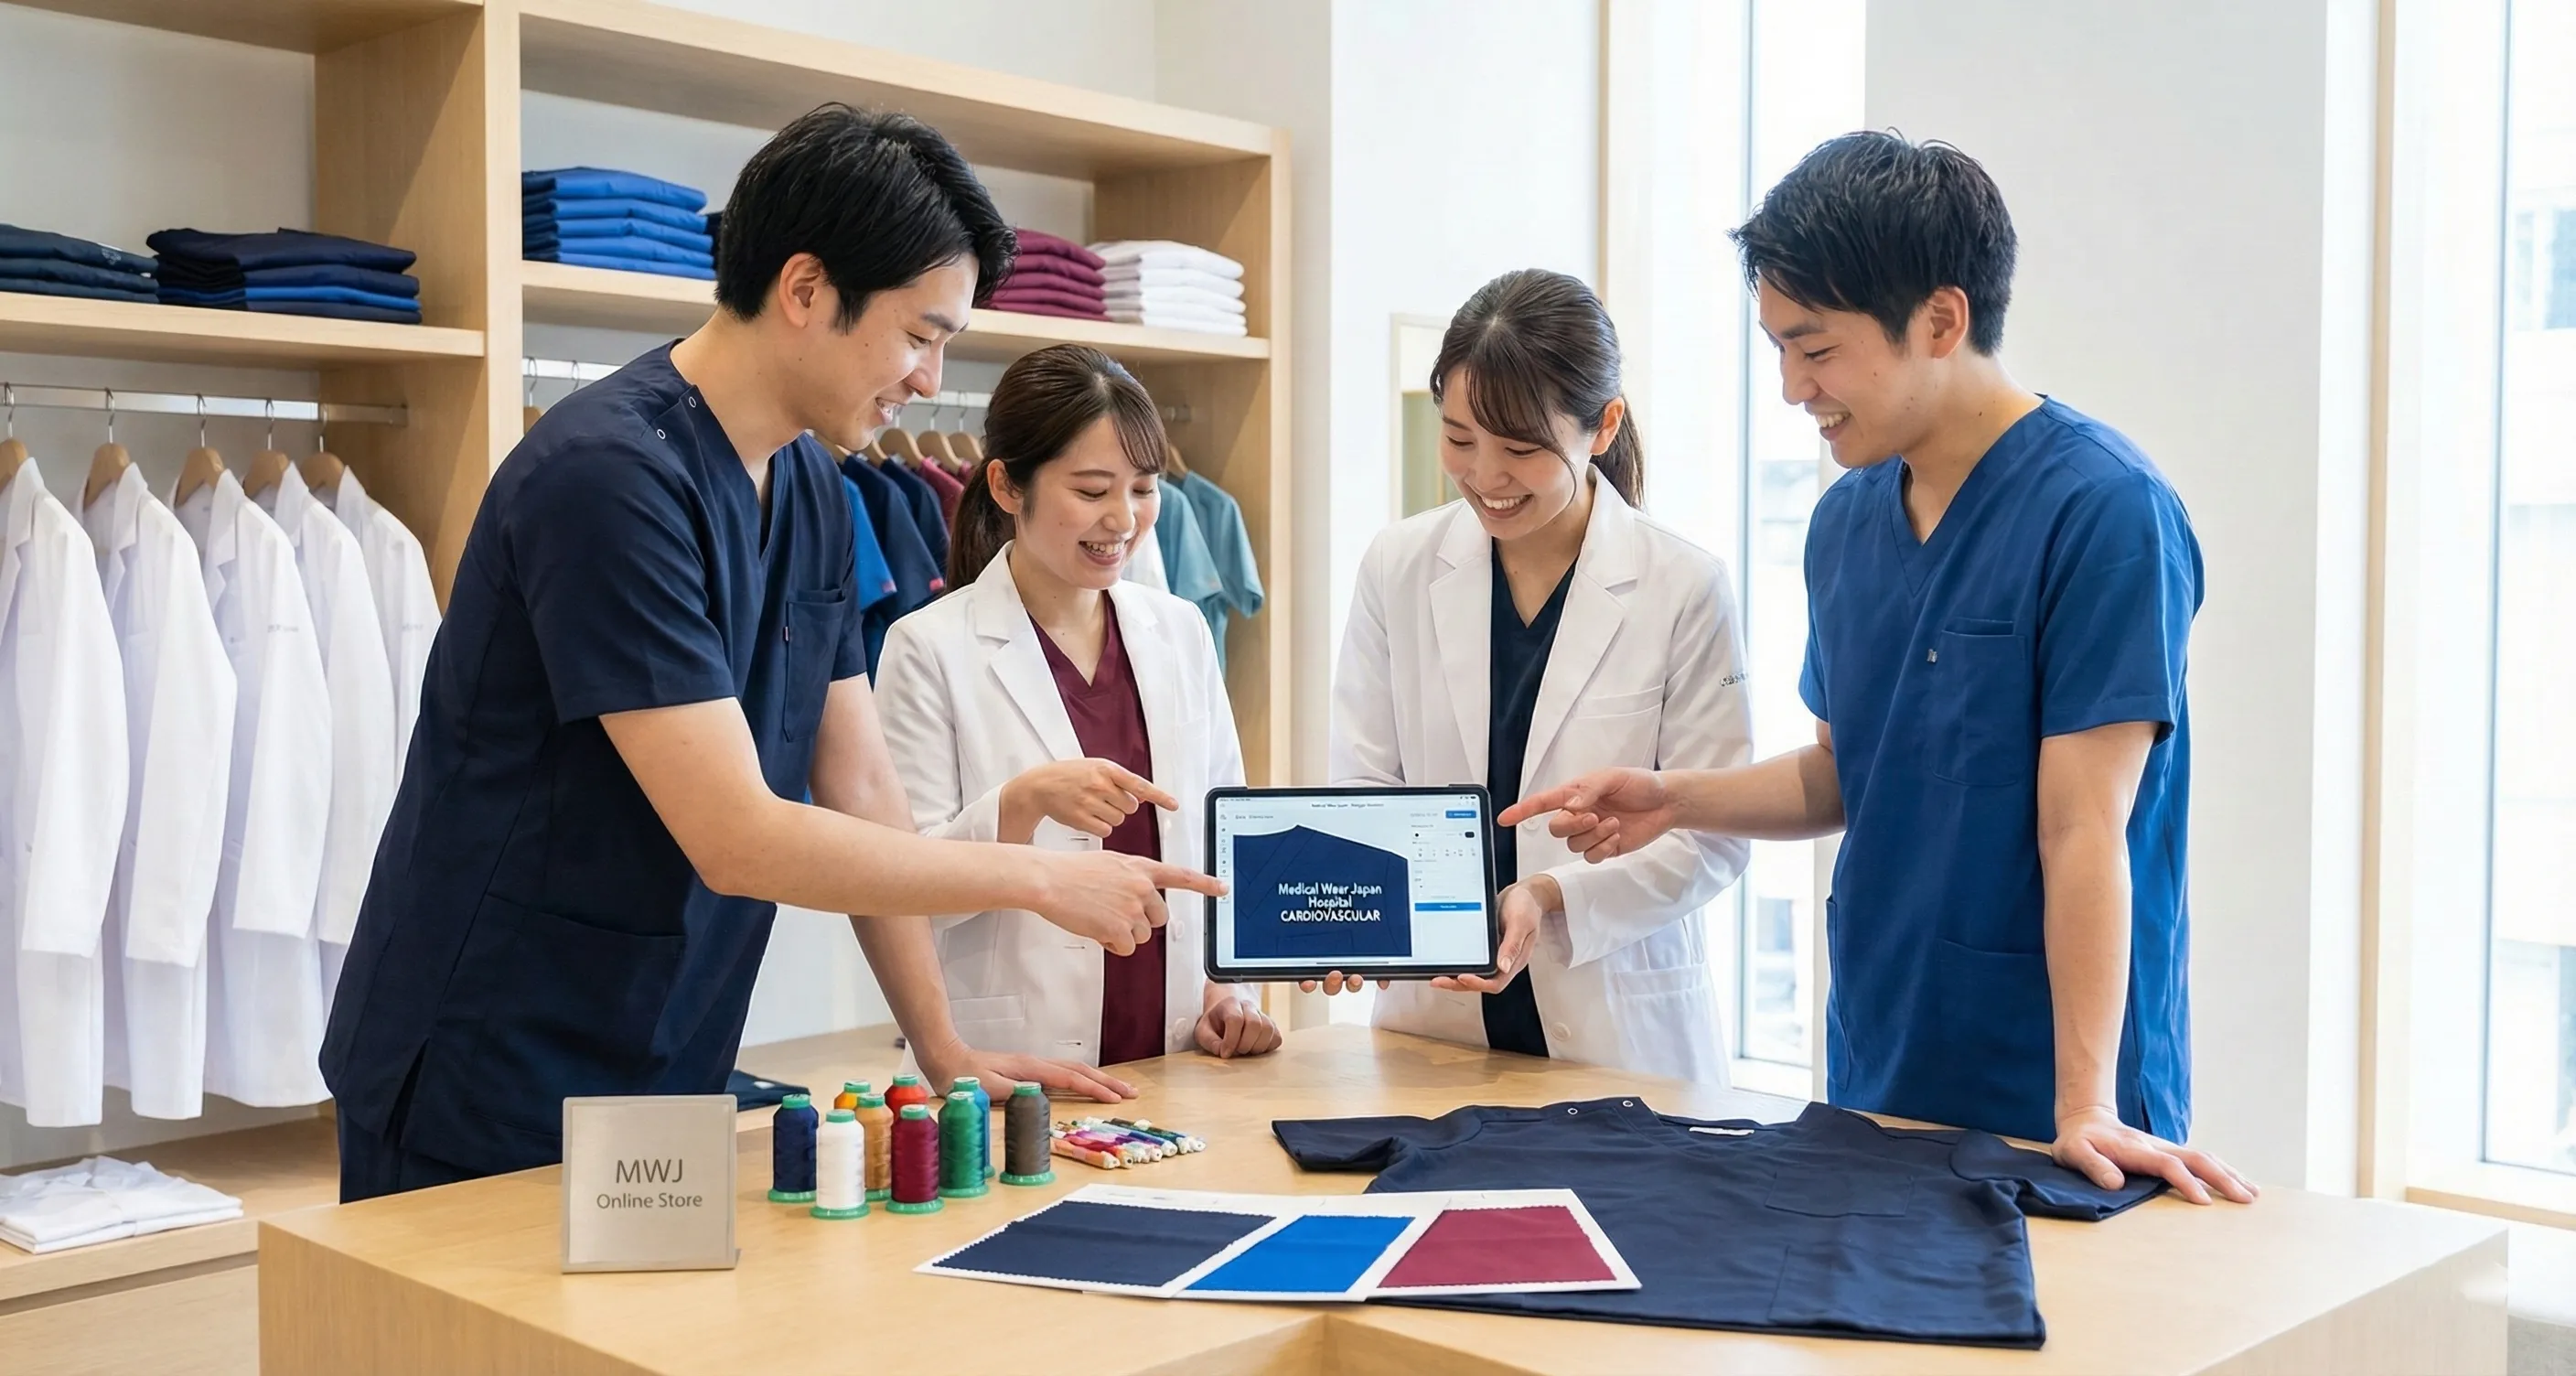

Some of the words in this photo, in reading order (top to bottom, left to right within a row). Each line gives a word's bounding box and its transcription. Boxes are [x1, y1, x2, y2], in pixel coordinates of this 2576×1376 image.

[1278, 882, 1318, 895] Medical
[1321, 882, 1349, 895] Wear
[1350, 882, 1382, 898] Japan
[1280, 908, 1380, 922] CARDIOVASCULAR
[616, 1158, 682, 1184] MWJ
[596, 1192, 654, 1209] Online
[659, 1192, 703, 1208] Store
